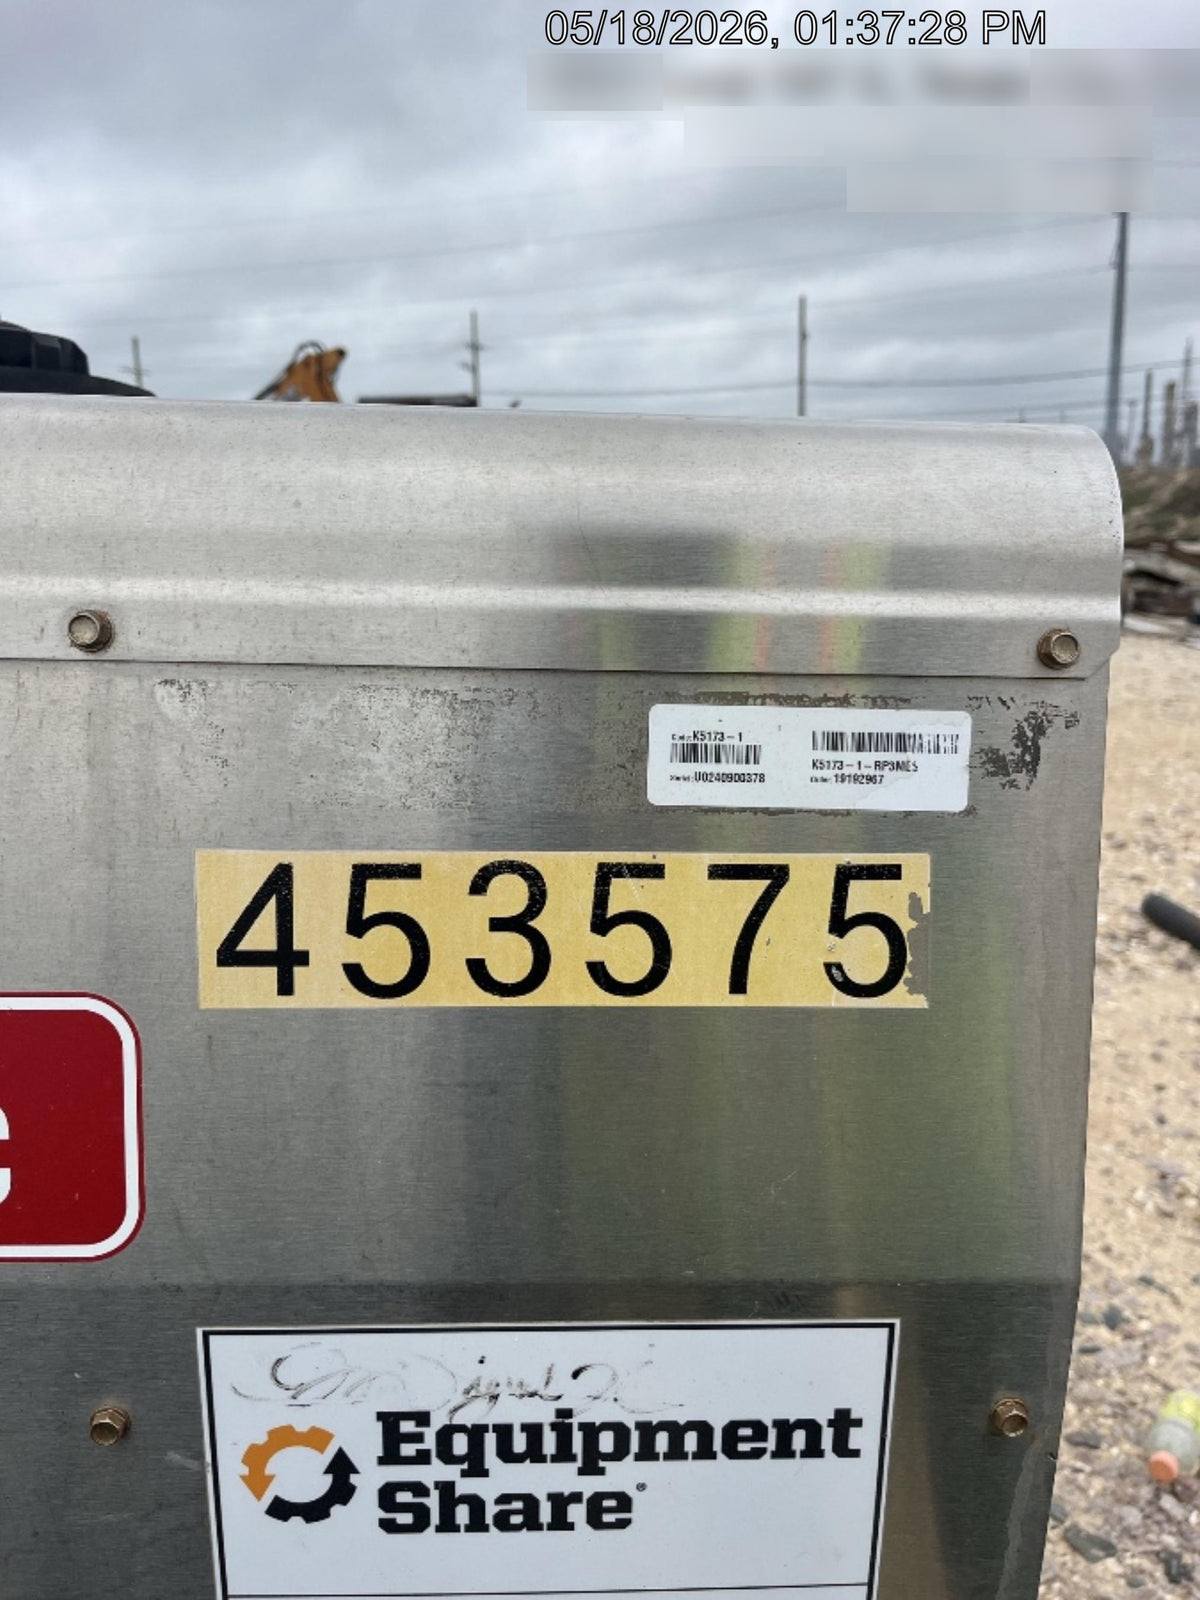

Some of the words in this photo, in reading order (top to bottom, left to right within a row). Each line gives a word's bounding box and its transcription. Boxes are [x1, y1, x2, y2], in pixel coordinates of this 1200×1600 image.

[215, 860, 909, 998] 453575
[376, 1407, 863, 1478] Equipment
[377, 1480, 634, 1534] Share
